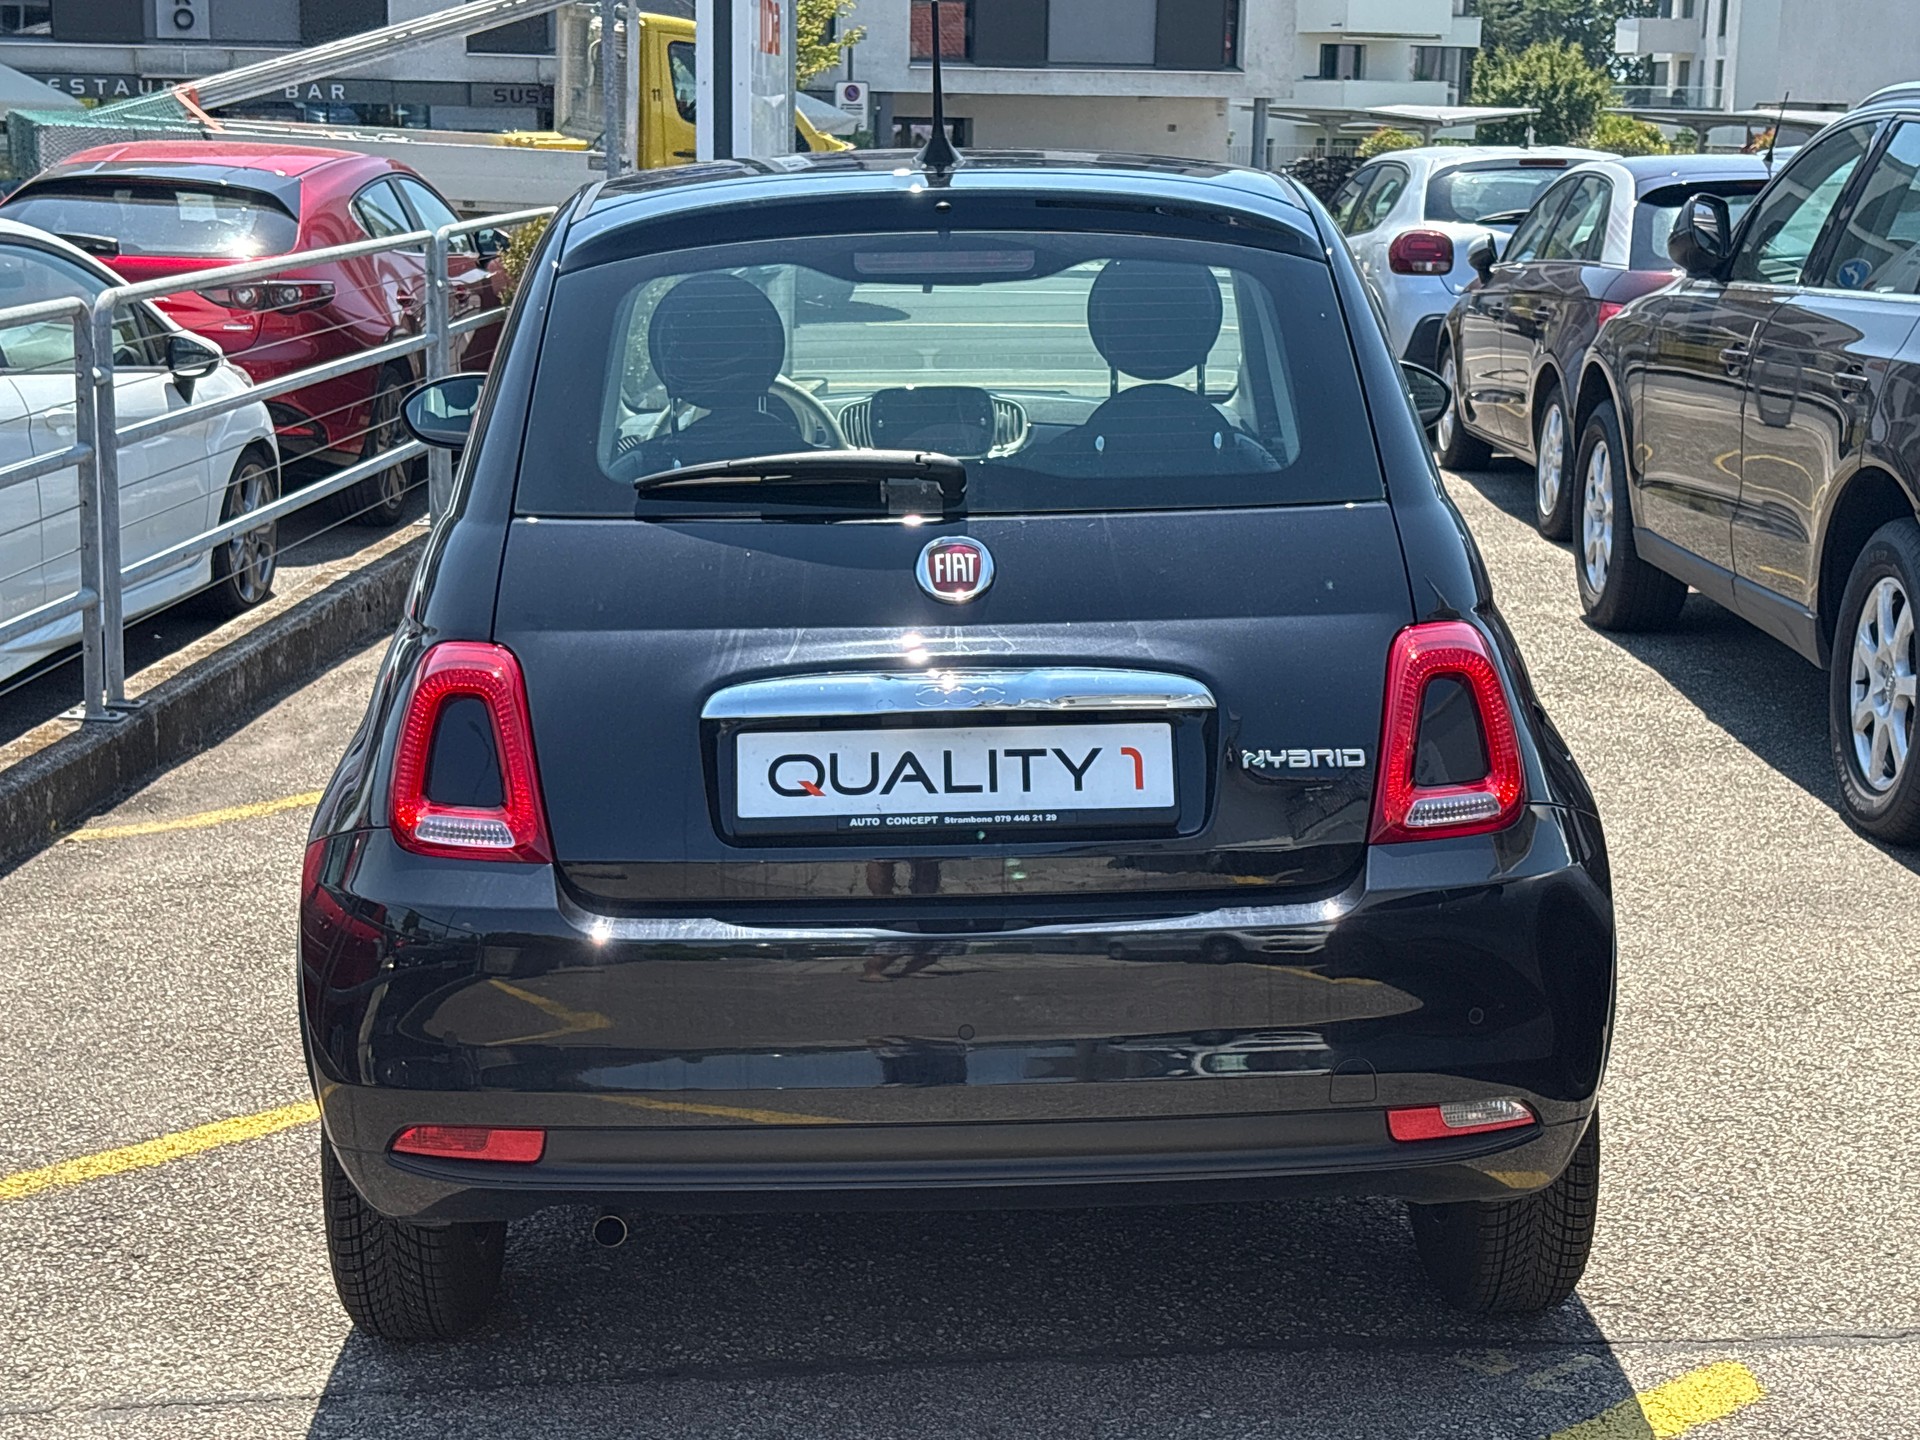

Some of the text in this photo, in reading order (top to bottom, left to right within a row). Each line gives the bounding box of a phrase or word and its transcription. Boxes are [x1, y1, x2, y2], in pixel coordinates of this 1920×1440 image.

[285, 83, 345, 100] BAR
[934, 552, 978, 583] FIAT
[1241, 748, 1366, 769] HYBRID
[768, 746, 1144, 797] QUALITY 1
[849, 817, 880, 827] AUTO
[886, 815, 939, 826] CONCEPT
[994, 814, 1012, 824] 079
[1013, 814, 1030, 823] 446
[1032, 813, 1043, 823] 21
[1045, 813, 1058, 823] 29
